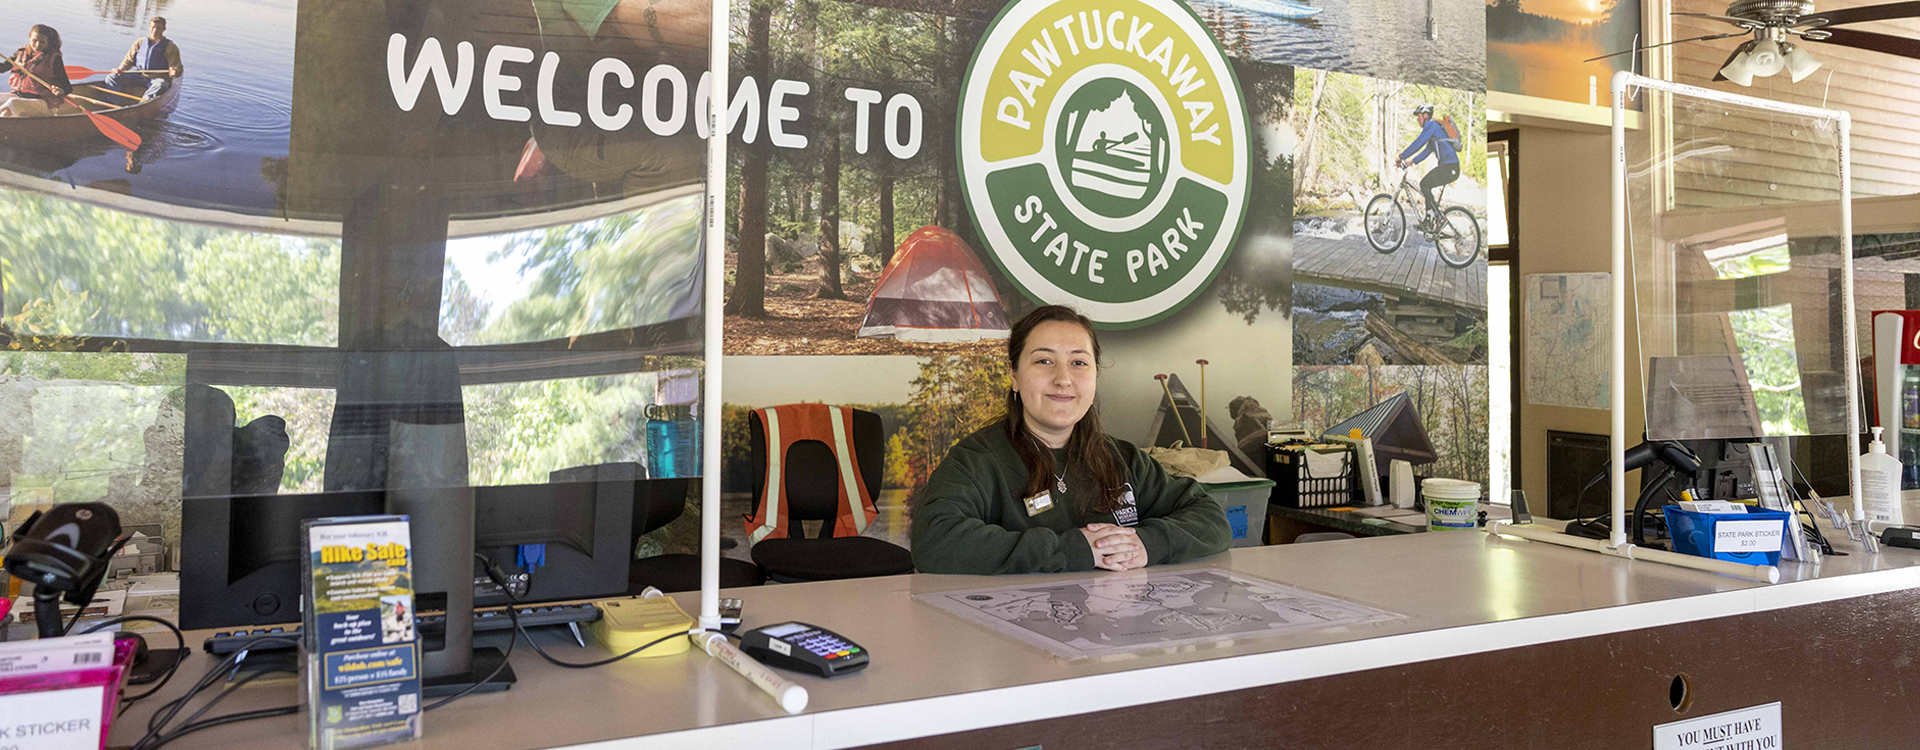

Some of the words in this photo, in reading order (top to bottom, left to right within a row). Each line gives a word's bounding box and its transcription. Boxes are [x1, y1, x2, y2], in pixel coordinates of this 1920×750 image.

[996, 9, 1221, 146] PAWTUCKAWAY
[386, 32, 810, 149] WELCOME
[844, 86, 923, 160] TO
[1013, 195, 1108, 284] STATE
[1126, 207, 1204, 283] PARK
[322, 545, 363, 563] Hike
[367, 542, 407, 560] Safe
[15, 718, 91, 738] STICKER
[1677, 730, 1701, 747] YOU
[1703, 723, 1733, 741] MUST
[1734, 718, 1761, 735] HAVE
[1756, 735, 1777, 750] YOU
